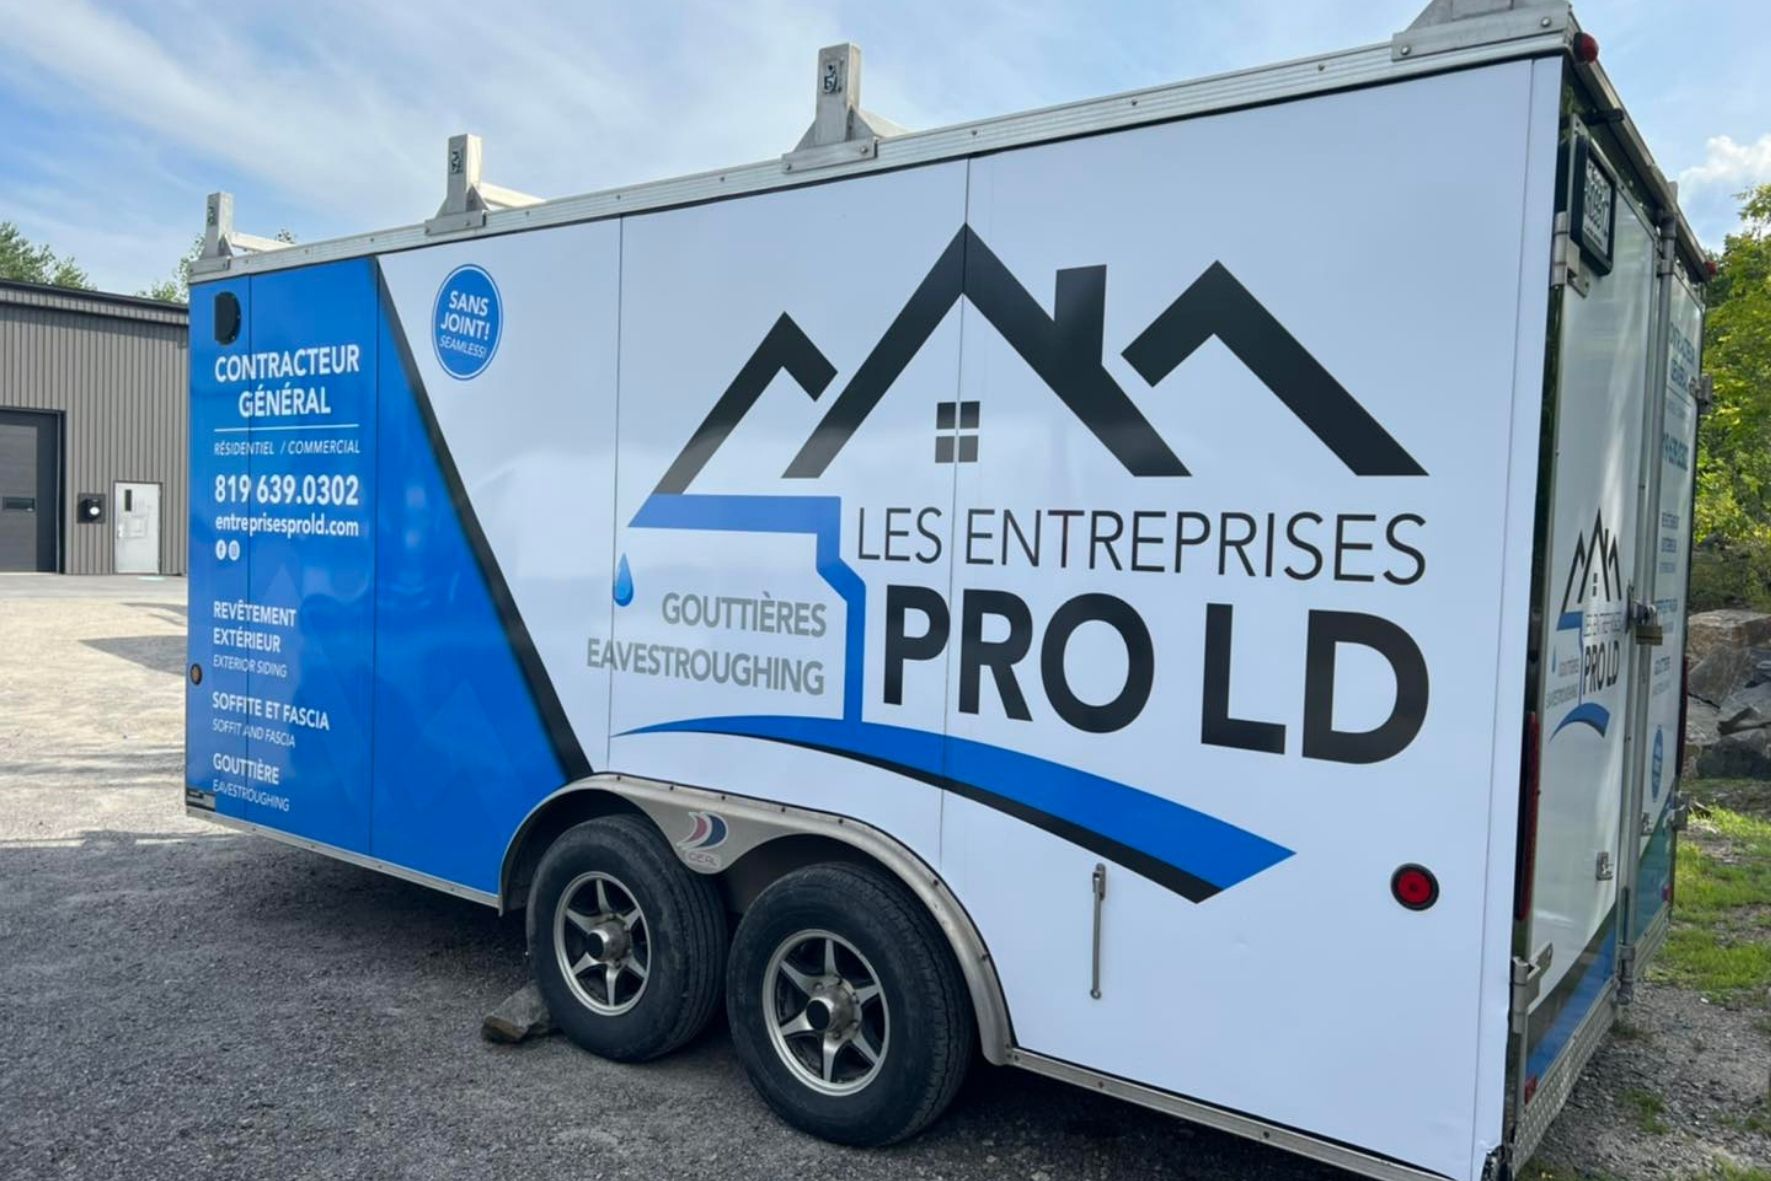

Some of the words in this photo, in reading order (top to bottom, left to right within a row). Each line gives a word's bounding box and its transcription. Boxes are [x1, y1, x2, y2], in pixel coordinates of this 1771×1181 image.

[449, 290, 489, 316] SANS
[440, 312, 490, 340] JOINT!
[215, 345, 359, 382] CONTRACTEUR
[239, 382, 331, 417] GÉNÉRAL
[214, 440, 274, 456] RÉSIDENTIEL
[215, 474, 251, 503] 819
[256, 474, 359, 505] 639.0302
[215, 512, 359, 539] entreprisesprold.com
[858, 506, 943, 564] LES
[965, 508, 1427, 586] ENTREPRISES
[213, 599, 297, 627] REVÊTEMENT
[662, 591, 827, 638] GOUTTIÈRES
[213, 627, 280, 653] EXTÉRIEUR
[213, 654, 255, 673] EXTERIOR
[256, 660, 288, 678] SIDING
[586, 637, 825, 697] EAVESTROUGHING
[883, 584, 1155, 734] PRO
[1200, 602, 1430, 765] LD
[1583, 641, 1605, 694] PRO
[212, 691, 261, 717] SOFFITE
[265, 701, 280, 720] ET
[283, 705, 330, 731] FASCIA
[213, 718, 242, 736] SOFFIT
[243, 725, 264, 741] AND
[265, 728, 296, 748] FASCIA
[213, 752, 279, 785] GOUTTIÈRE
[213, 779, 290, 813] EAVESTROUGHING
